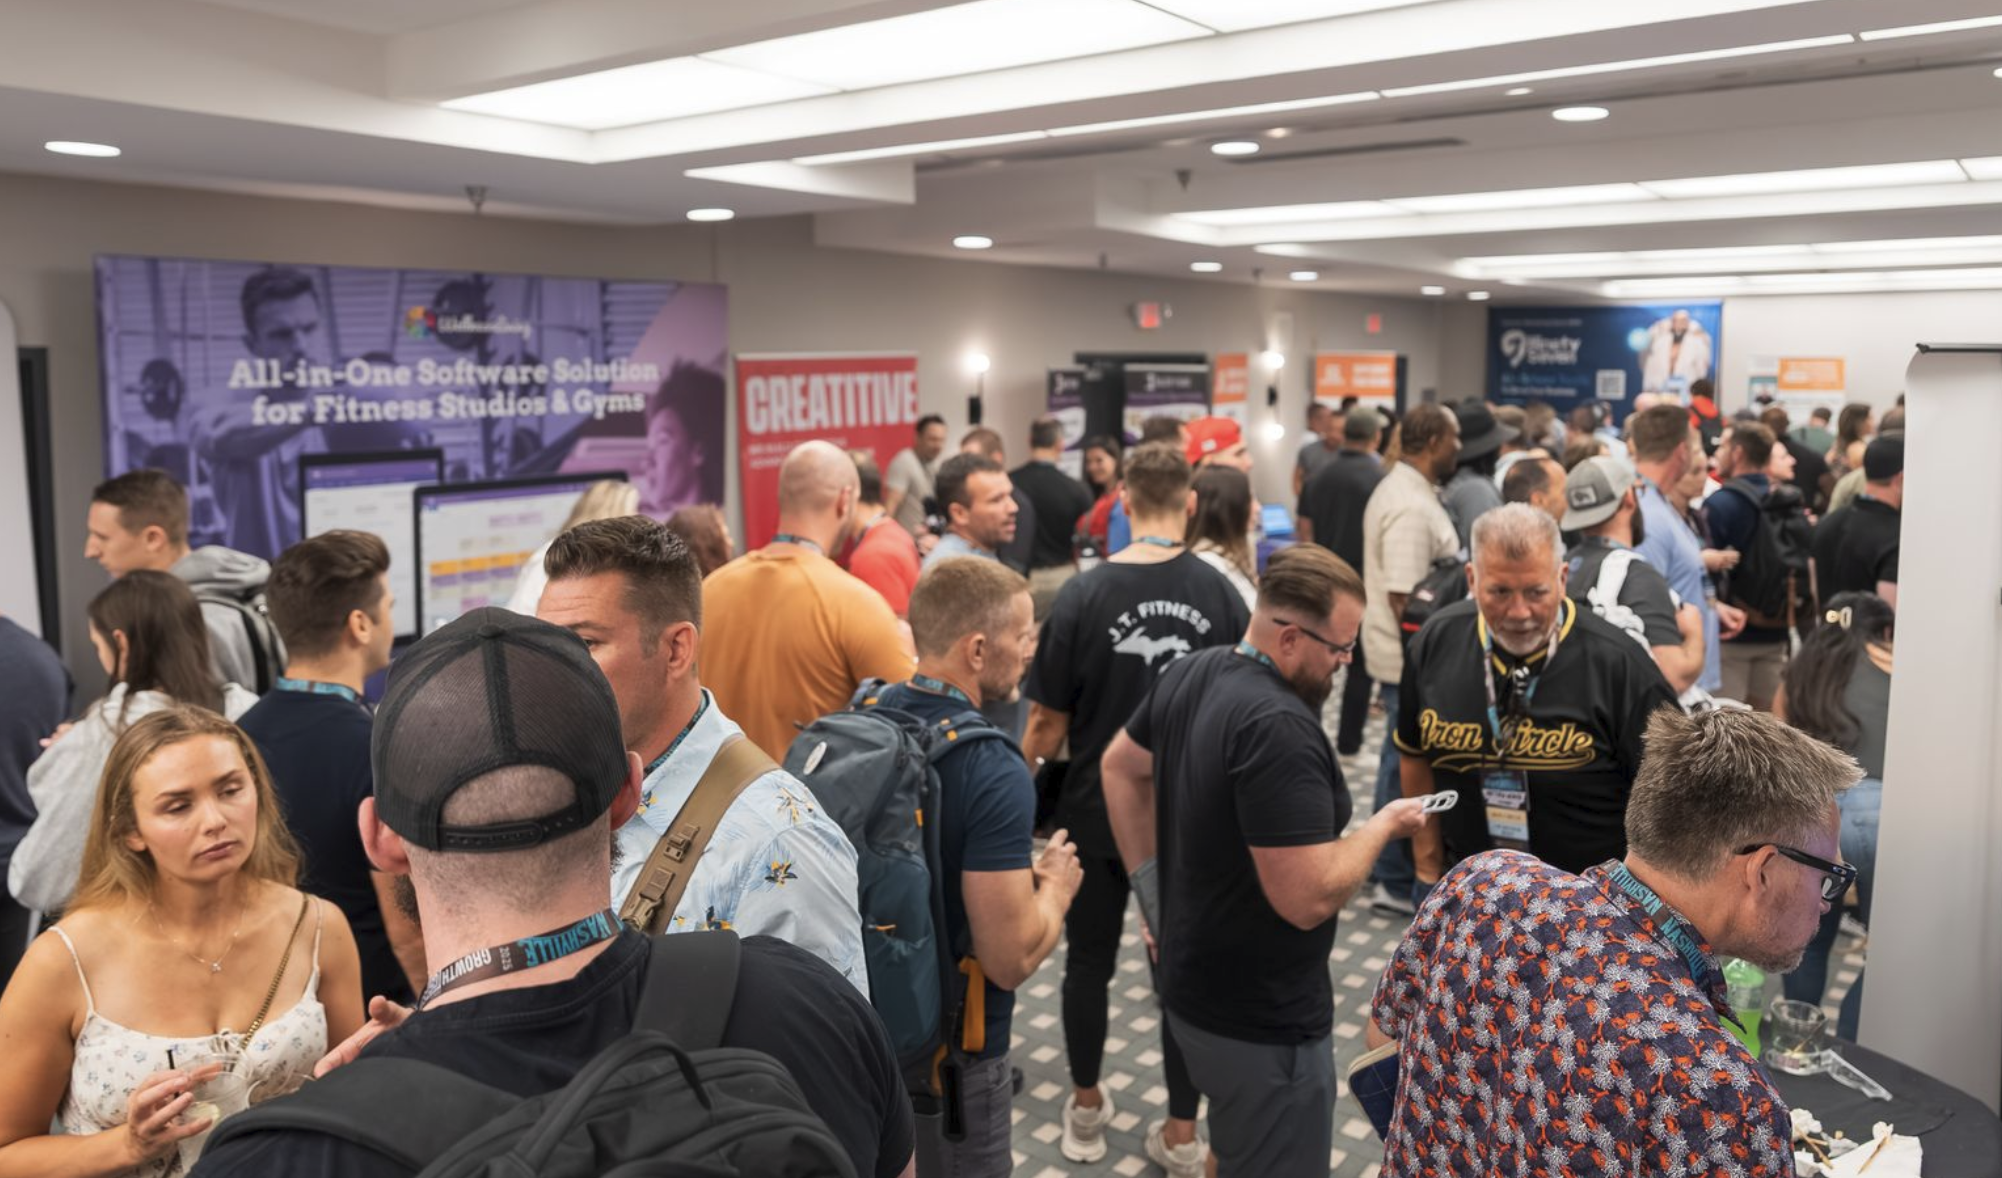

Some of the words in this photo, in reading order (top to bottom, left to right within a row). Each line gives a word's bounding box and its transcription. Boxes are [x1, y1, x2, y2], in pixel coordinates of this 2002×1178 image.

[227, 357, 412, 389] All-in-One
[417, 356, 549, 387] Software
[553, 356, 660, 384] Solution
[252, 394, 307, 426] for
[313, 392, 434, 424] Fitness
[437, 388, 548, 420] Studios
[551, 387, 571, 415] &
[573, 387, 646, 420] Gyms
[745, 371, 918, 436] CREATITIVE
[1107, 611, 1138, 643] J.T.
[1137, 600, 1212, 635] FITNESS
[1420, 708, 1483, 751] Iron
[1608, 862, 1663, 916] NASHVILLE
[499, 946, 513, 971] 2025
[518, 911, 612, 968] NASHVILLE
[440, 947, 492, 985] GROWTH
